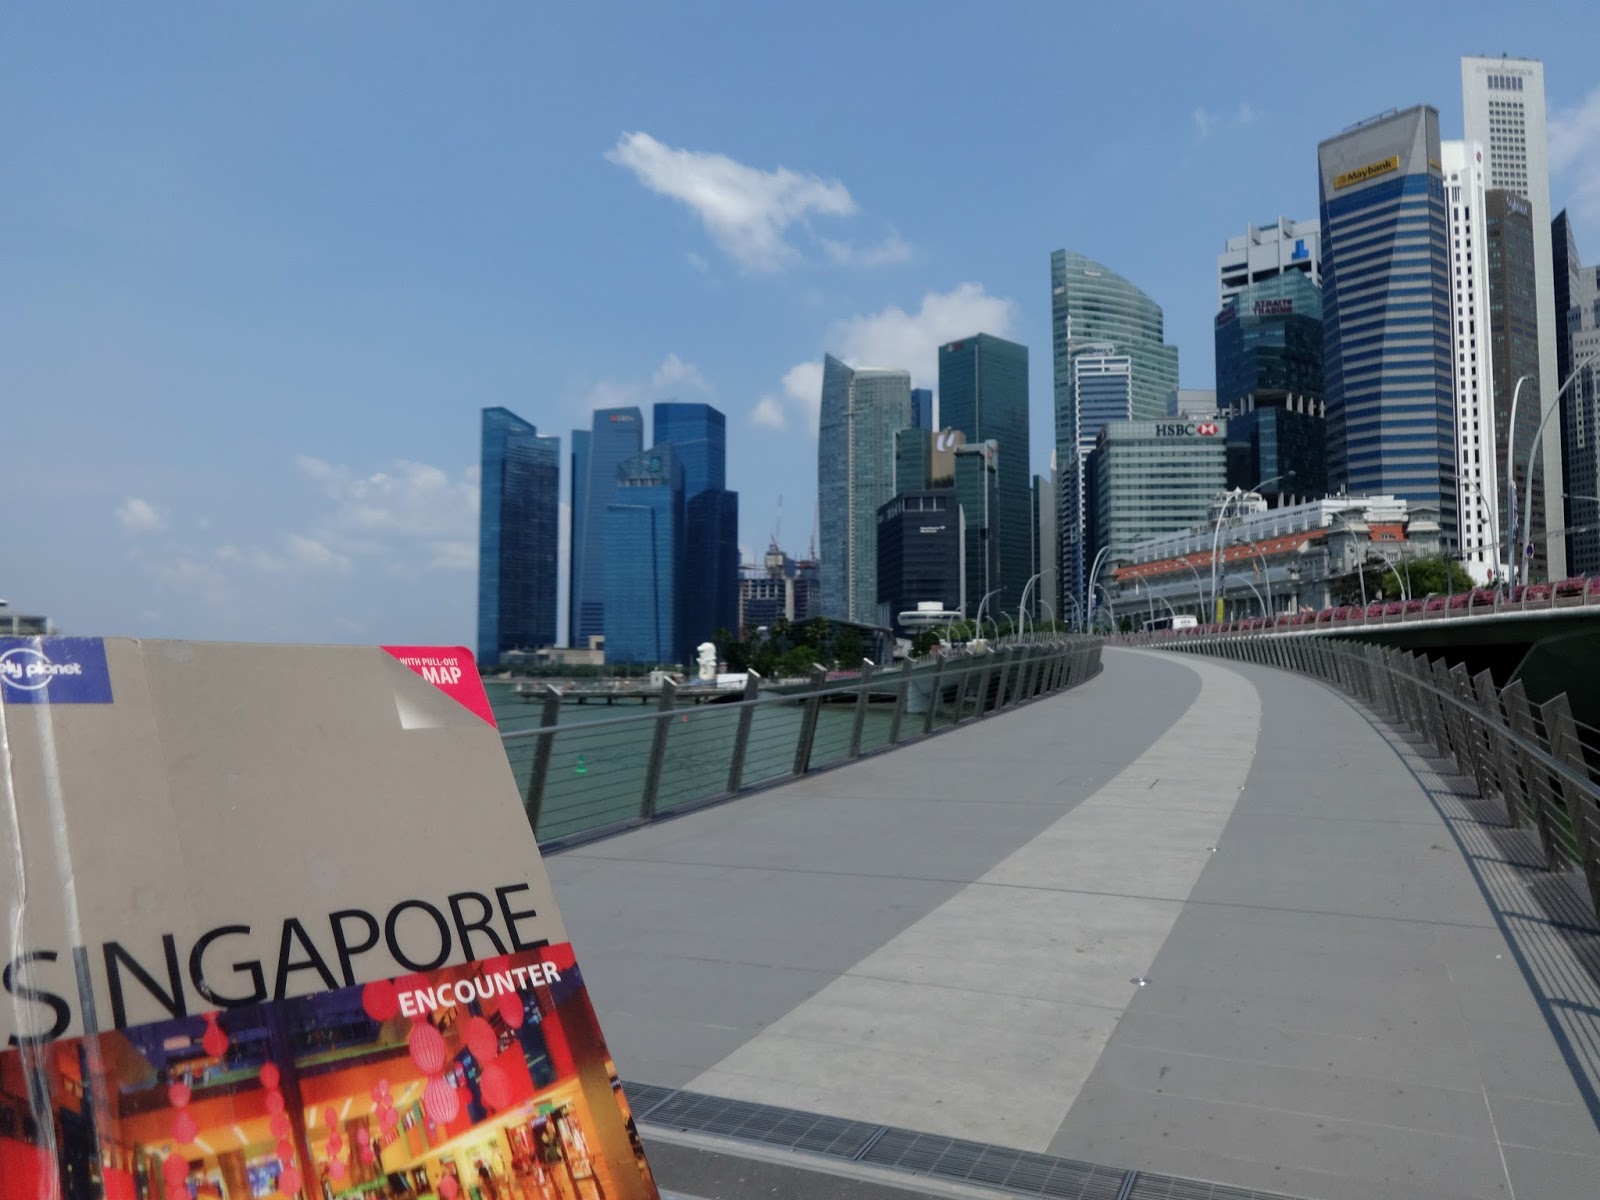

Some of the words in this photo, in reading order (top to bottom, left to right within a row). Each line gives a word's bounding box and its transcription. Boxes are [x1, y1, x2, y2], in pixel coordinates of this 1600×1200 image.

[1347, 158, 1393, 182] Maybank
[1156, 423, 1196, 437] HSBC
[26, 660, 82, 678] planet
[399, 657, 422, 666] WITH
[422, 657, 458, 667] PULL-OUT
[421, 666, 462, 685] MAP
[2, 883, 550, 1047] SINGAPORE
[398, 961, 562, 1018] ENCOUNTER
